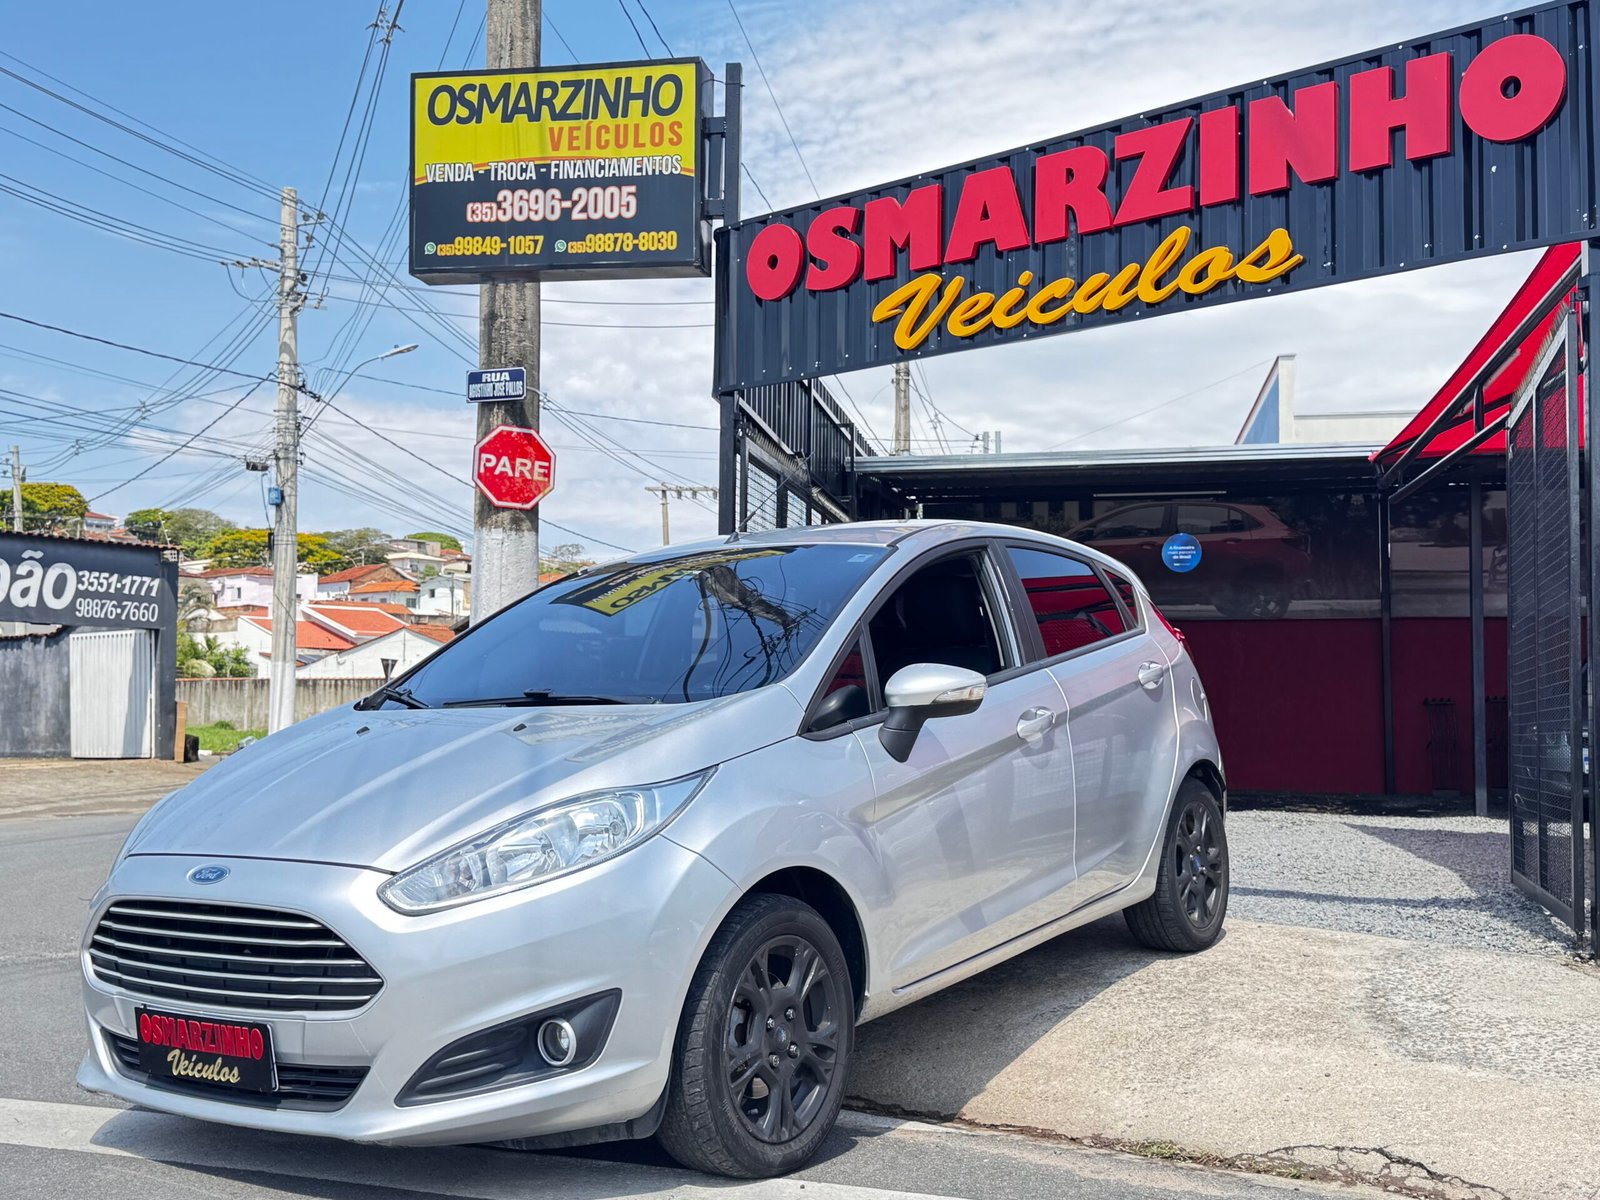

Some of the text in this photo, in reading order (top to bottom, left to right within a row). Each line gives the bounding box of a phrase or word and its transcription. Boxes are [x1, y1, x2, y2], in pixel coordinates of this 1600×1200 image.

[427, 73, 683, 126] OSMARZINHO
[548, 120, 683, 152] VEÍCULOS
[425, 161, 475, 183] VENDA
[489, 160, 537, 182] TROCA
[550, 154, 682, 180] FINANCIAMENTOS
[746, 33, 1567, 302] OSMARZINHO
[872, 225, 1305, 351] Veiculos
[481, 372, 510, 382] RUA
[479, 453, 550, 482] PARE
[195, 868, 221, 879] Ford
[140, 1013, 264, 1060] OSMARZINHO
